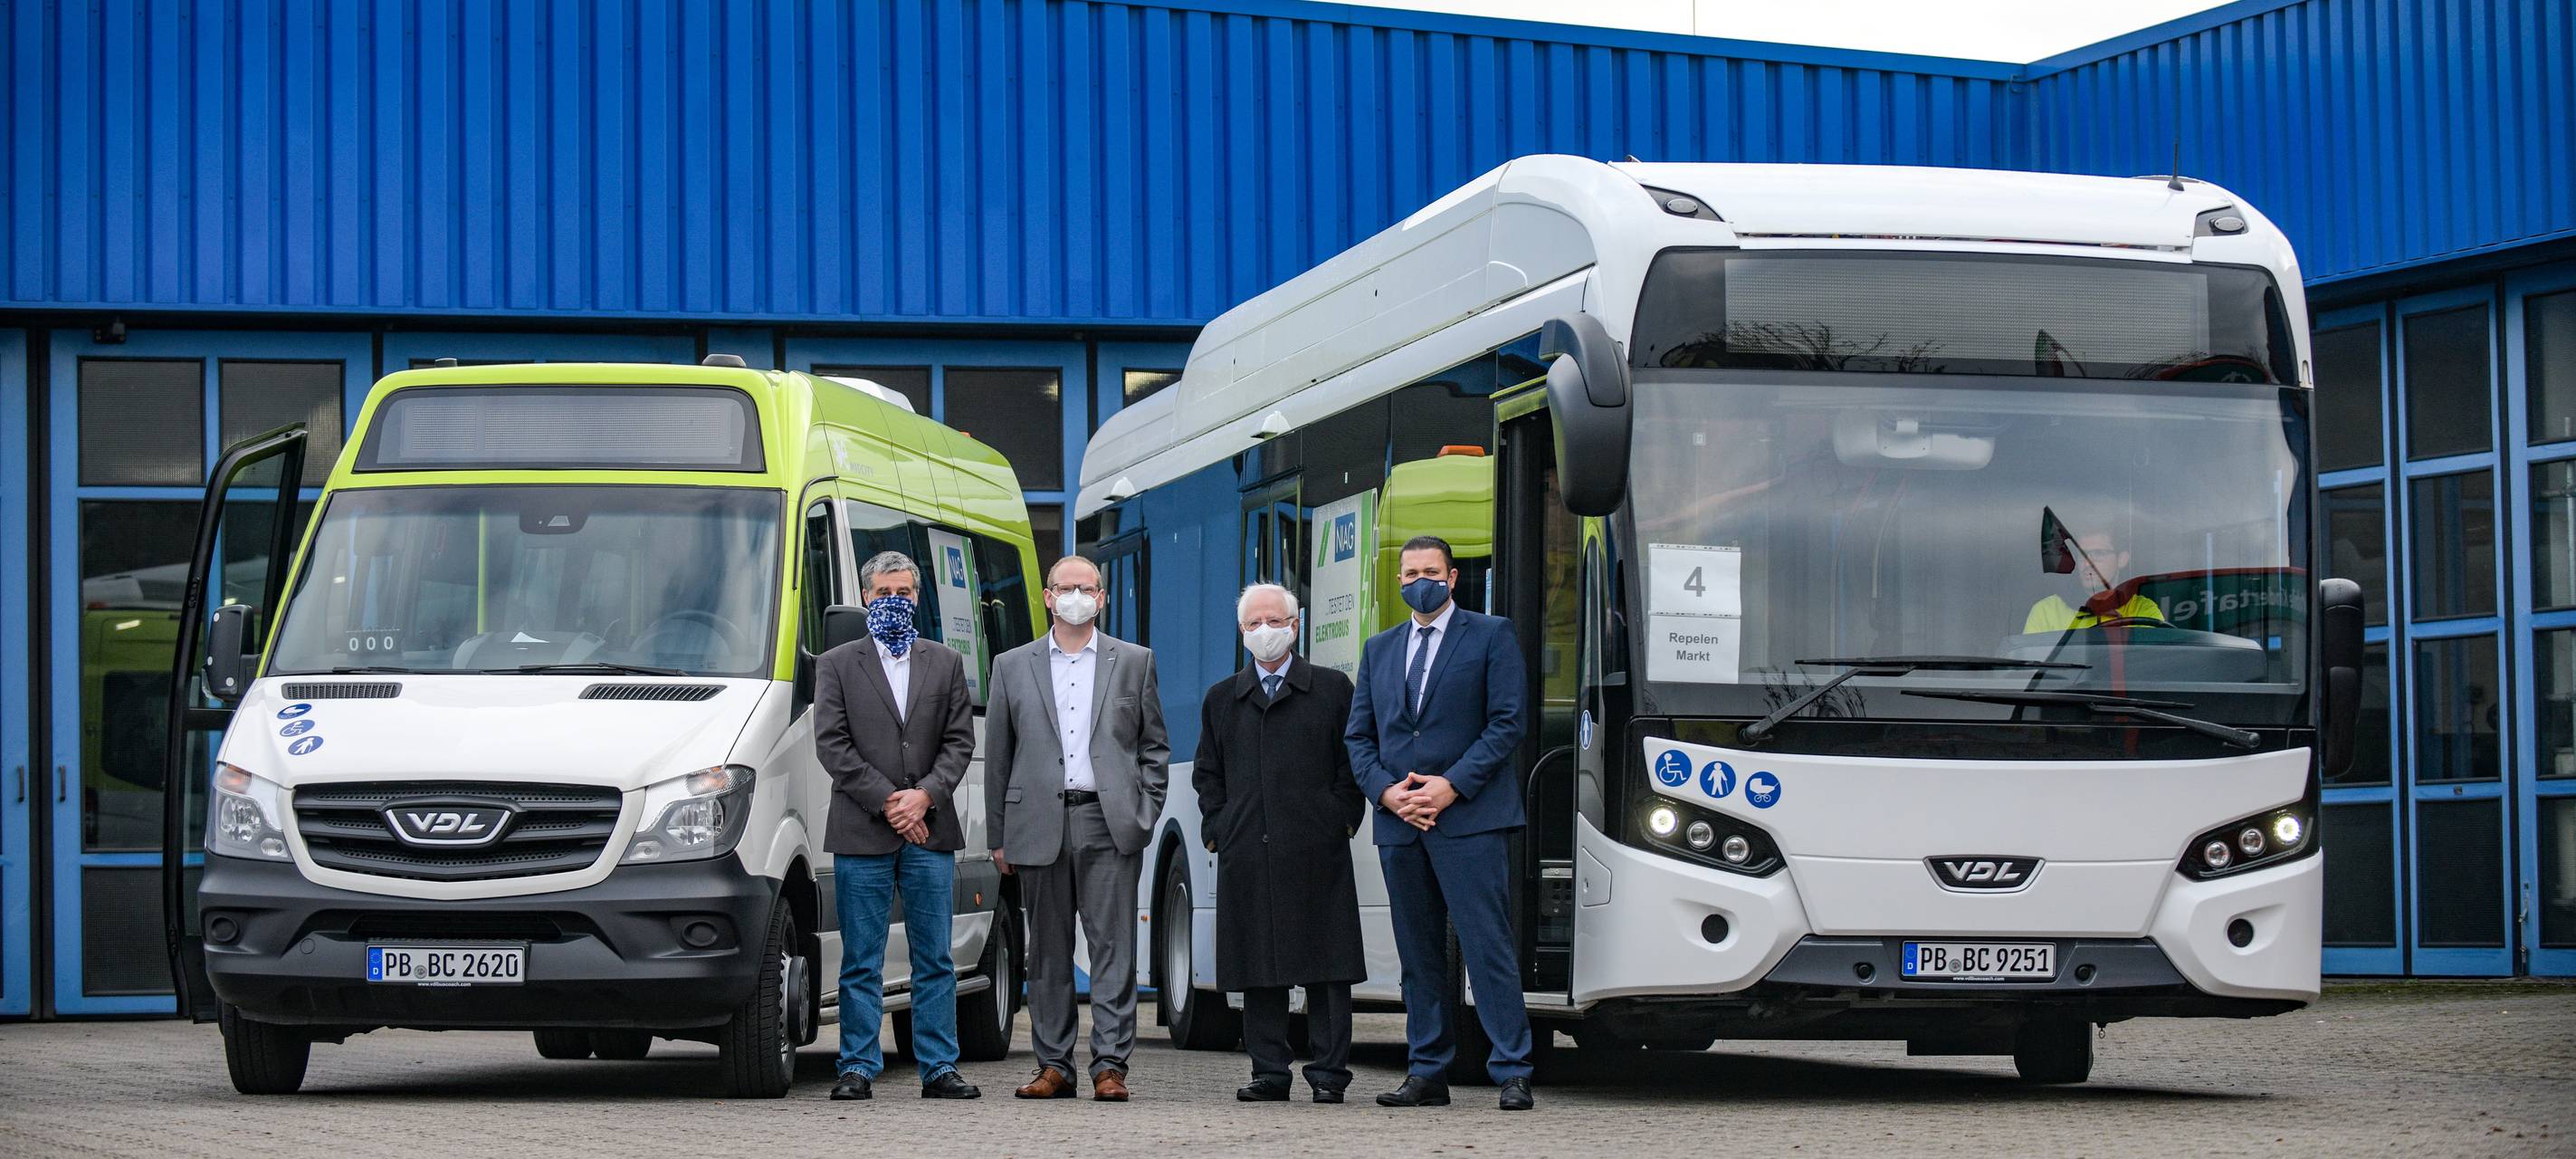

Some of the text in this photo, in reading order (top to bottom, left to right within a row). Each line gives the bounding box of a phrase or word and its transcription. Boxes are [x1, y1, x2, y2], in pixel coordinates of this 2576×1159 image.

[1336, 521, 1354, 554] NIAG
[950, 555, 964, 581] NIAG
[1684, 566, 1706, 598] 4
[1315, 619, 1350, 644] ELEKTROBUS
[1669, 633, 1718, 646] Repelen
[1676, 650, 1711, 662] Markt
[407, 812, 486, 833] VDL
[1943, 861, 2021, 881] VDL
[372, 953, 519, 977] D PB BC 2620
[1920, 947, 1947, 972] PB
[1962, 947, 1989, 972] BC
[1996, 948, 2049, 972] 9251
